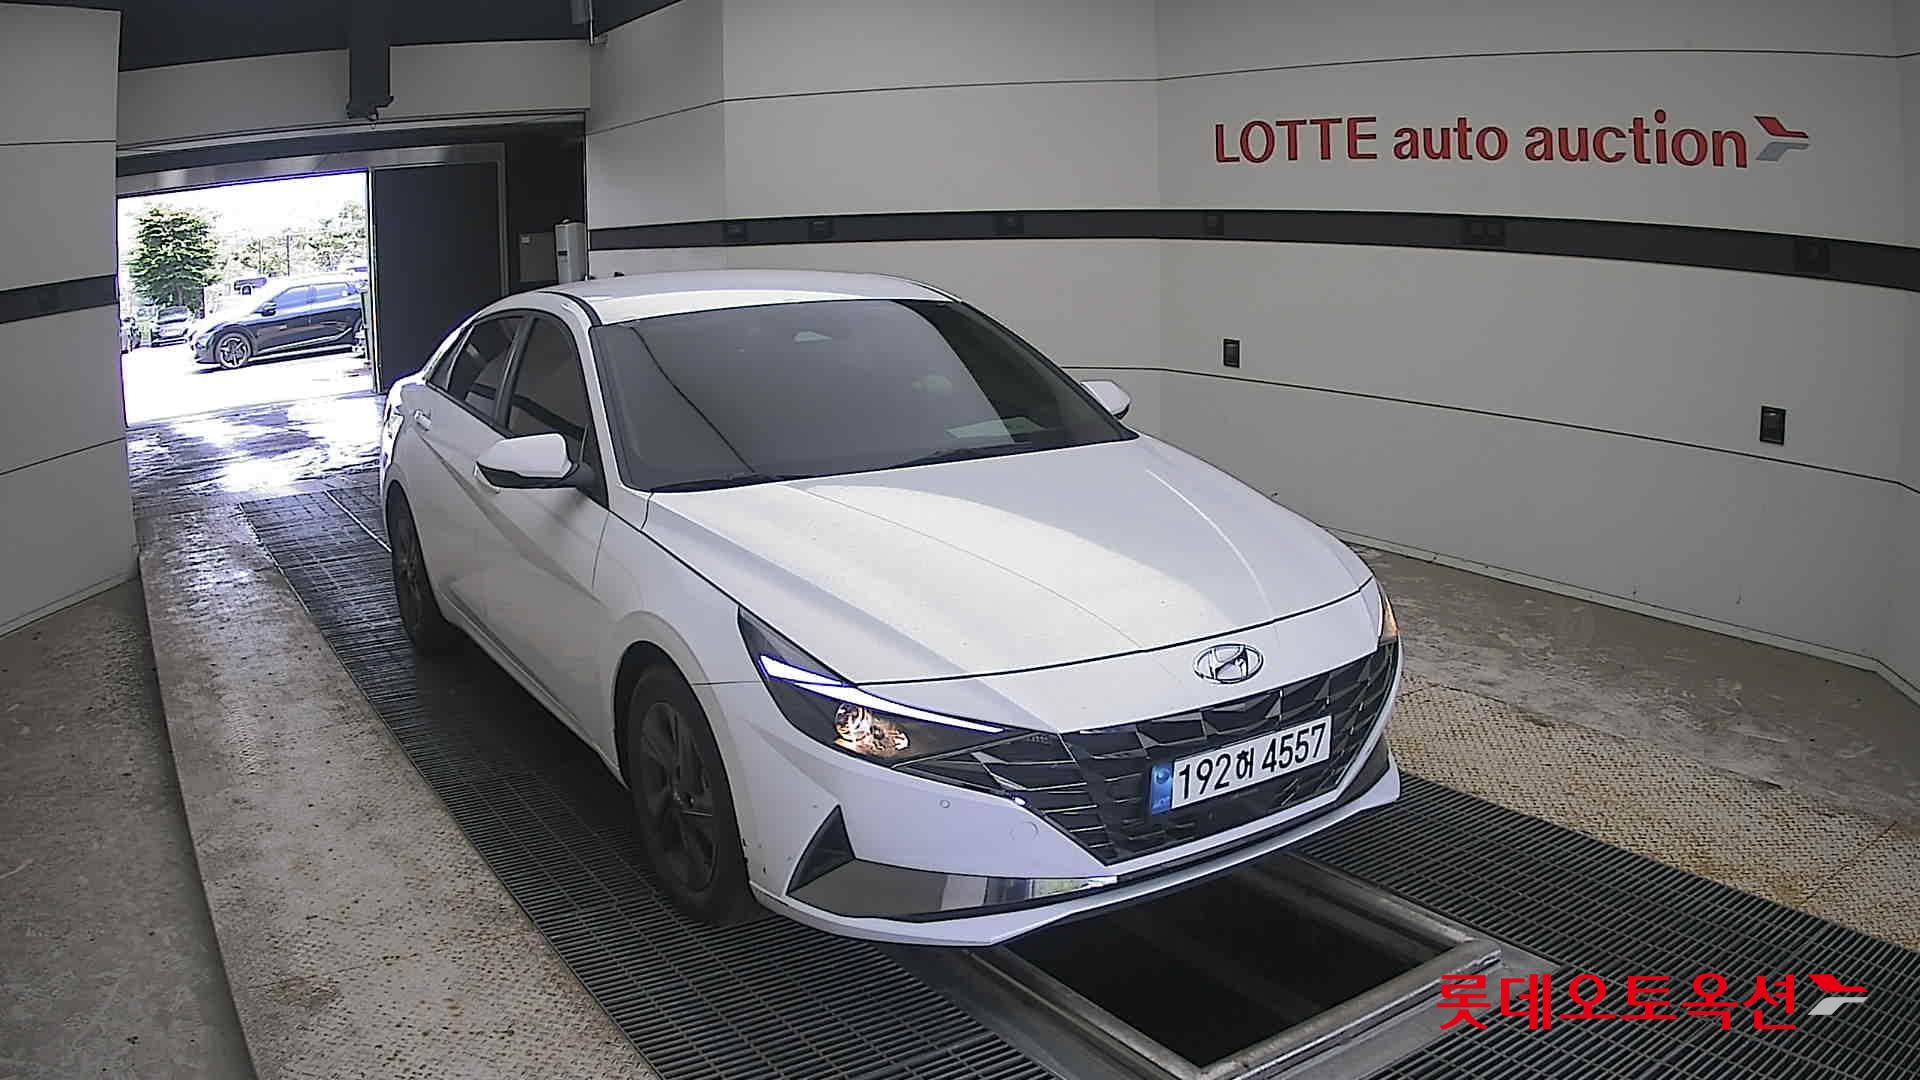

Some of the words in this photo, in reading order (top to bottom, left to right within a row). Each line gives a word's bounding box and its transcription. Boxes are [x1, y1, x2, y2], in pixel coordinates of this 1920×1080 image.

[1215, 116, 1377, 163] LOTTE
[1393, 117, 1509, 162] auto
[1525, 109, 1748, 169] auction
[1178, 747, 1255, 799] 192허
[1261, 722, 1327, 773] 4557
